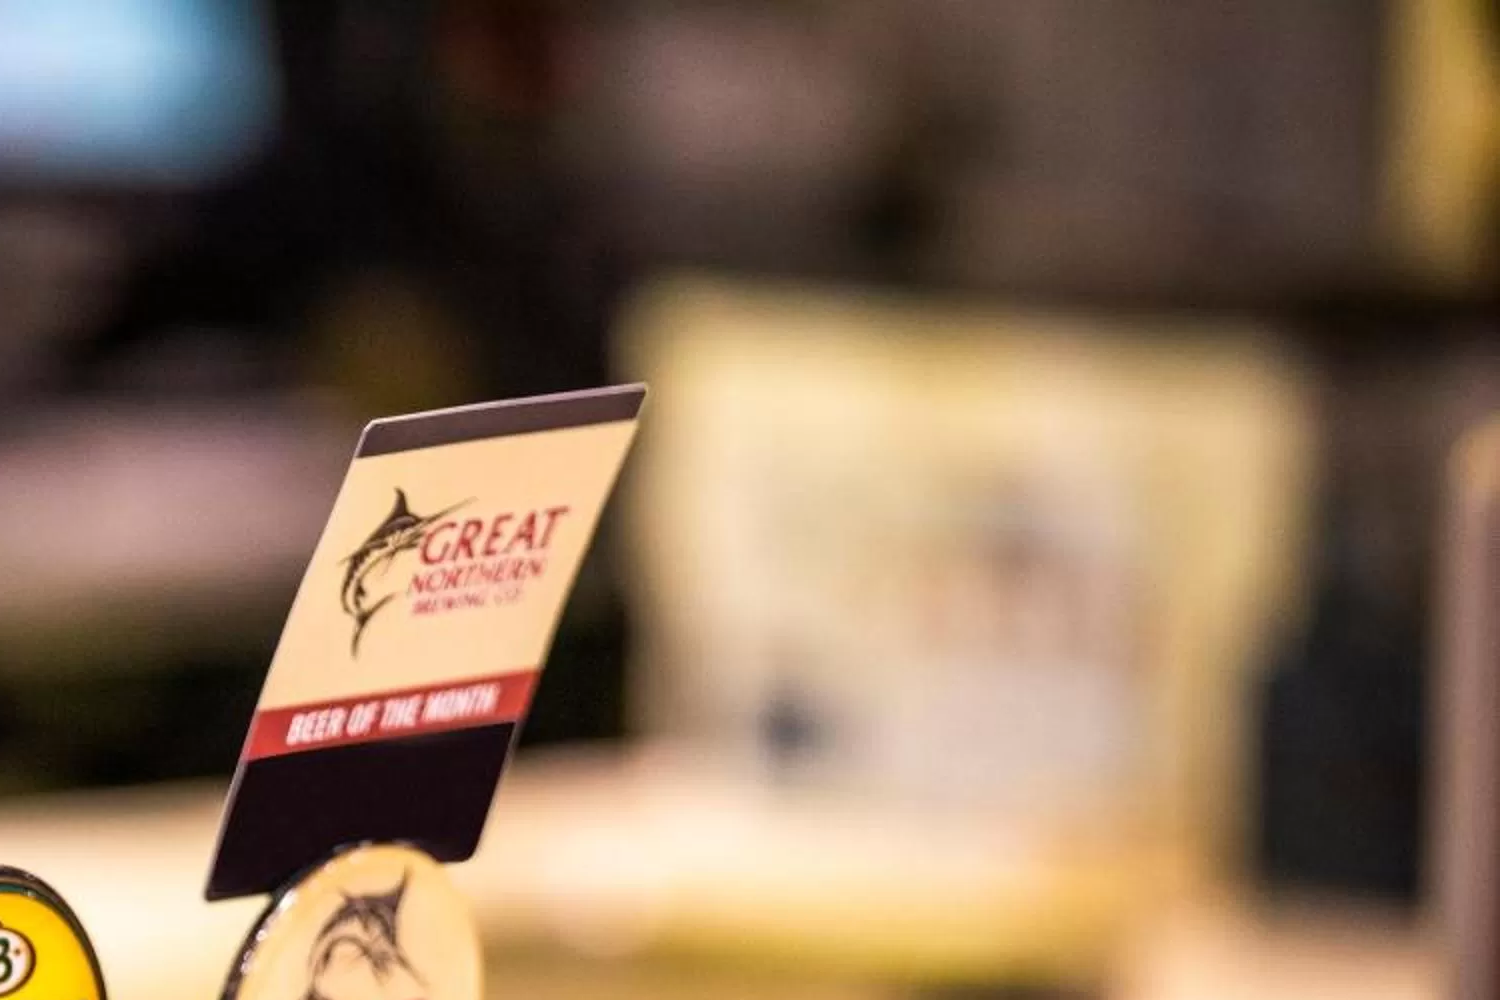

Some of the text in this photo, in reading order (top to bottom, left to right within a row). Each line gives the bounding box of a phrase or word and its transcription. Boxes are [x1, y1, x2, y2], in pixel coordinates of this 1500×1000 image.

[420, 505, 570, 565] GREAT
[407, 557, 548, 594] NORTHERN
[286, 683, 500, 746] BEER OF THE MONTH
